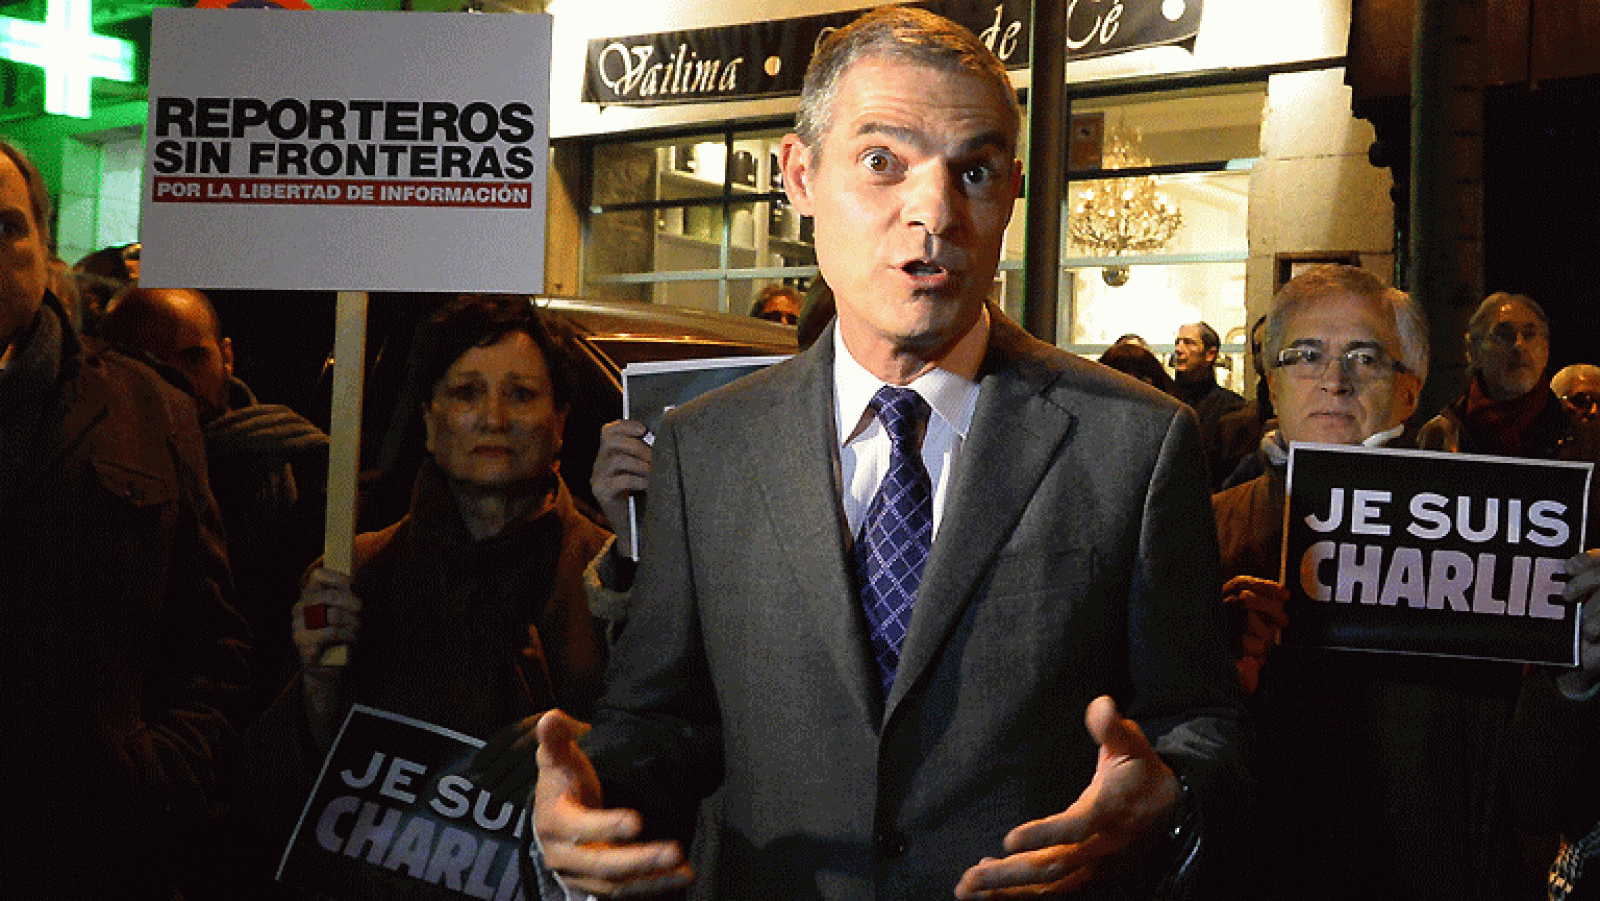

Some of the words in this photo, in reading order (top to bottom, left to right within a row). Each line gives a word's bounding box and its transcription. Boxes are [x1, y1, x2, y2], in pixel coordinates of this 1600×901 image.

[599, 42, 744, 96] Vailima
[979, 3, 1021, 61] de
[155, 97, 534, 143] REPORTEROS
[153, 140, 231, 174] SIN
[250, 143, 534, 179] FRONTERAS
[157, 181, 201, 198] POR
[207, 183, 233, 198] LA
[239, 182, 341, 199] LIBERTAD
[347, 184, 374, 201] DE
[380, 182, 528, 203] INFORMACIÓN
[1304, 487, 1392, 536] JE
[1406, 492, 1570, 547] SUIS
[1300, 540, 1567, 620] CHARLIE
[340, 751, 427, 804] JE
[429, 775, 526, 838] SUI
[315, 796, 524, 901] CHARLI
